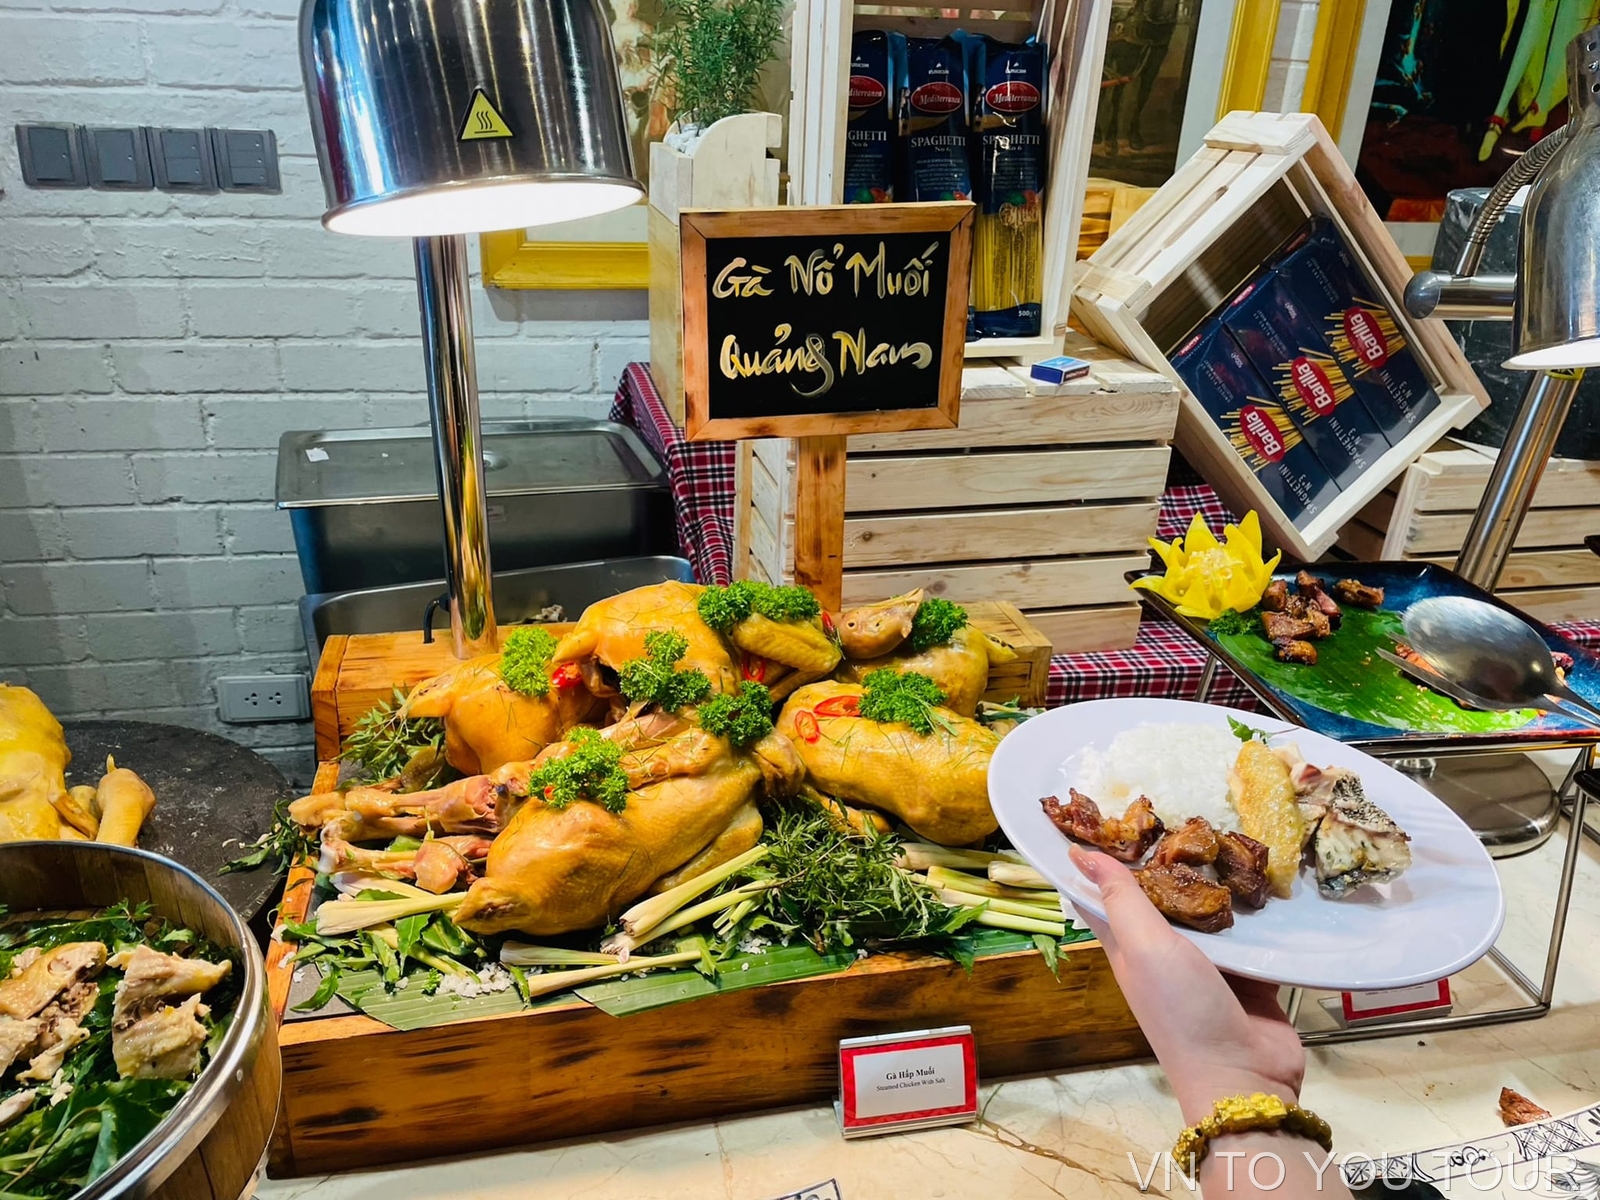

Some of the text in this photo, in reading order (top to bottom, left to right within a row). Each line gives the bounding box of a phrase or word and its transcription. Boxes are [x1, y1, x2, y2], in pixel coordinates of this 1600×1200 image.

[848, 87, 883, 98] diterranea
[848, 130, 887, 141] GHETTI
[911, 135, 966, 148] SPAGHETTI
[712, 240, 939, 299] Gà Nổ Muối
[719, 322, 933, 397] Quảng Nam
[1350, 313, 1388, 360] Barilla
[1296, 362, 1331, 408] Barilla
[1379, 369, 1416, 423] SPAGHETTINI
[1243, 407, 1281, 455] Barilla
[1328, 416, 1365, 468] SPAGHETTINI
[1278, 463, 1316, 513] SPAGHETTINI
[876, 1083, 899, 1091] Steamed
[899, 1080, 921, 1088] Chicken
[886, 1066, 935, 1080] Gà Hấp Muối
